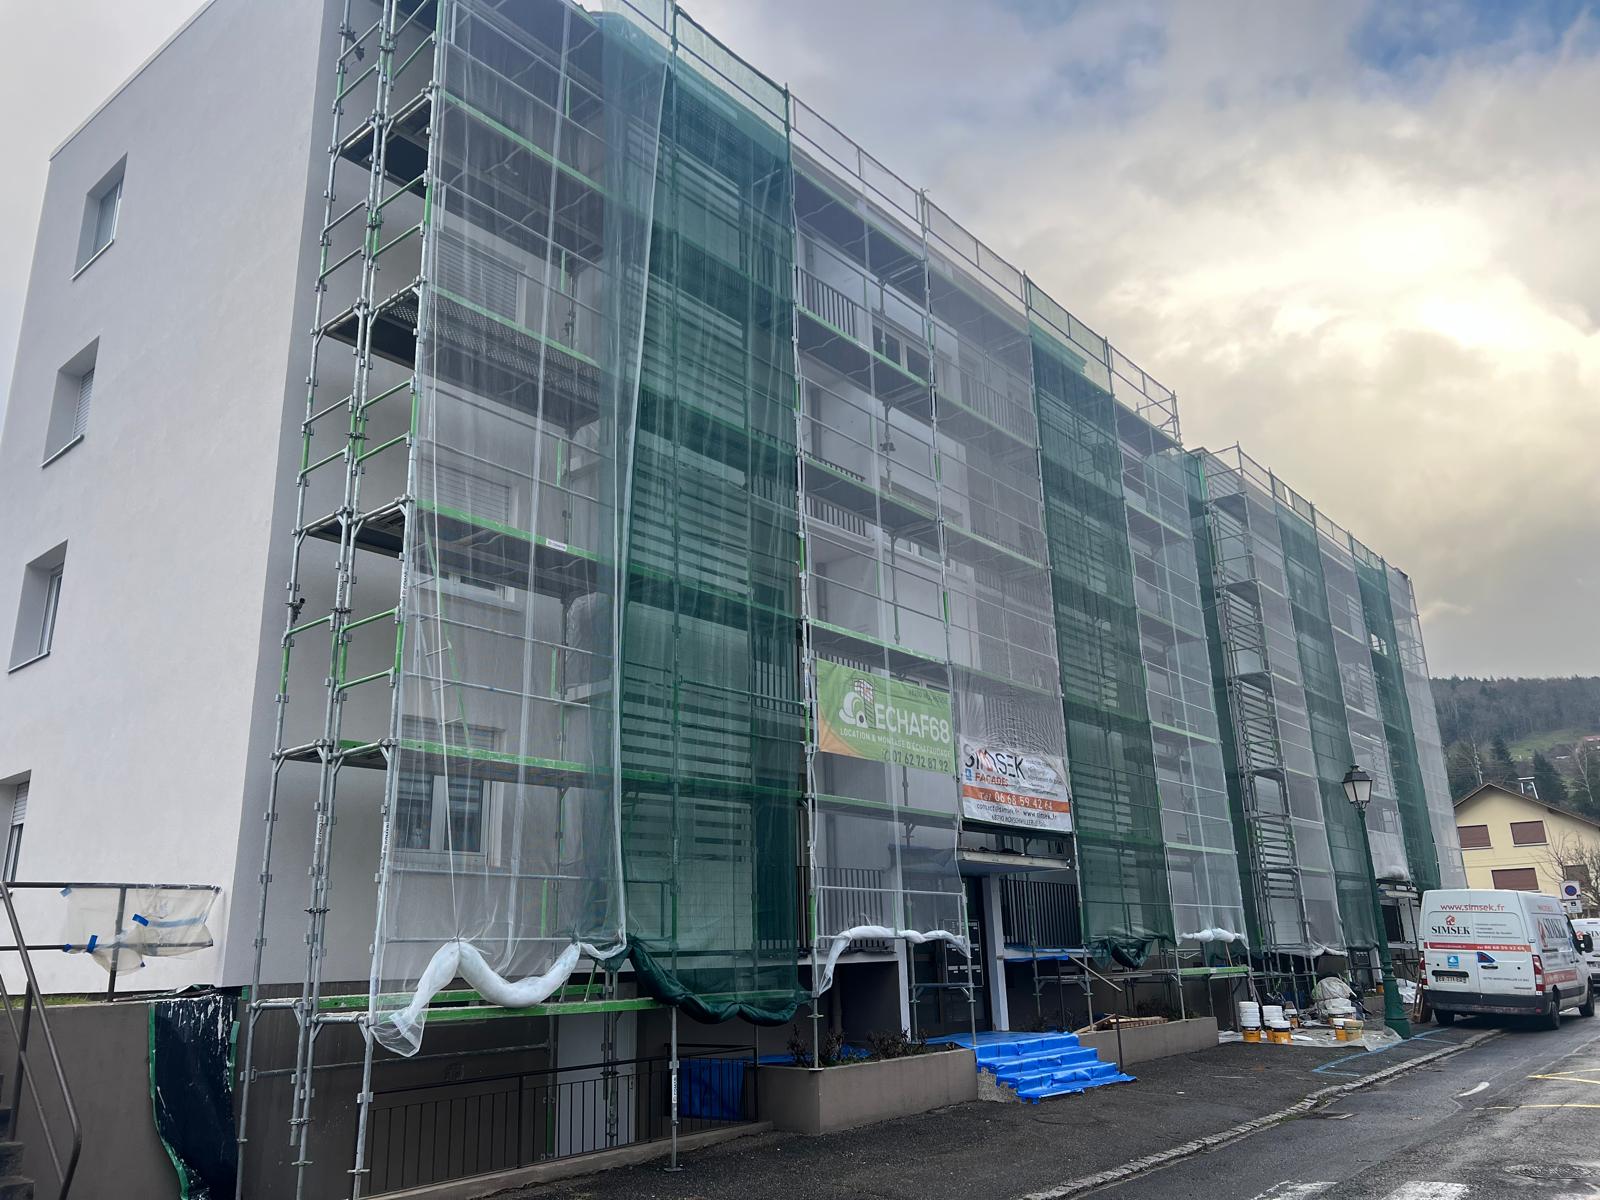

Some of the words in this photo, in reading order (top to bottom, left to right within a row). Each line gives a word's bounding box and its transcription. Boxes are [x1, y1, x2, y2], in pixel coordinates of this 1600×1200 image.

[875, 704, 950, 744] ECHAF68
[840, 727, 871, 741] LOCATION
[892, 750, 902, 763] 07
[905, 752, 914, 766] 62
[916, 755, 926, 768] 72
[928, 757, 937, 770] 87
[994, 791, 1005, 803] 06
[1440, 903, 1505, 912] www.simsek.fr
[1431, 925, 1471, 935] SIMSEK
